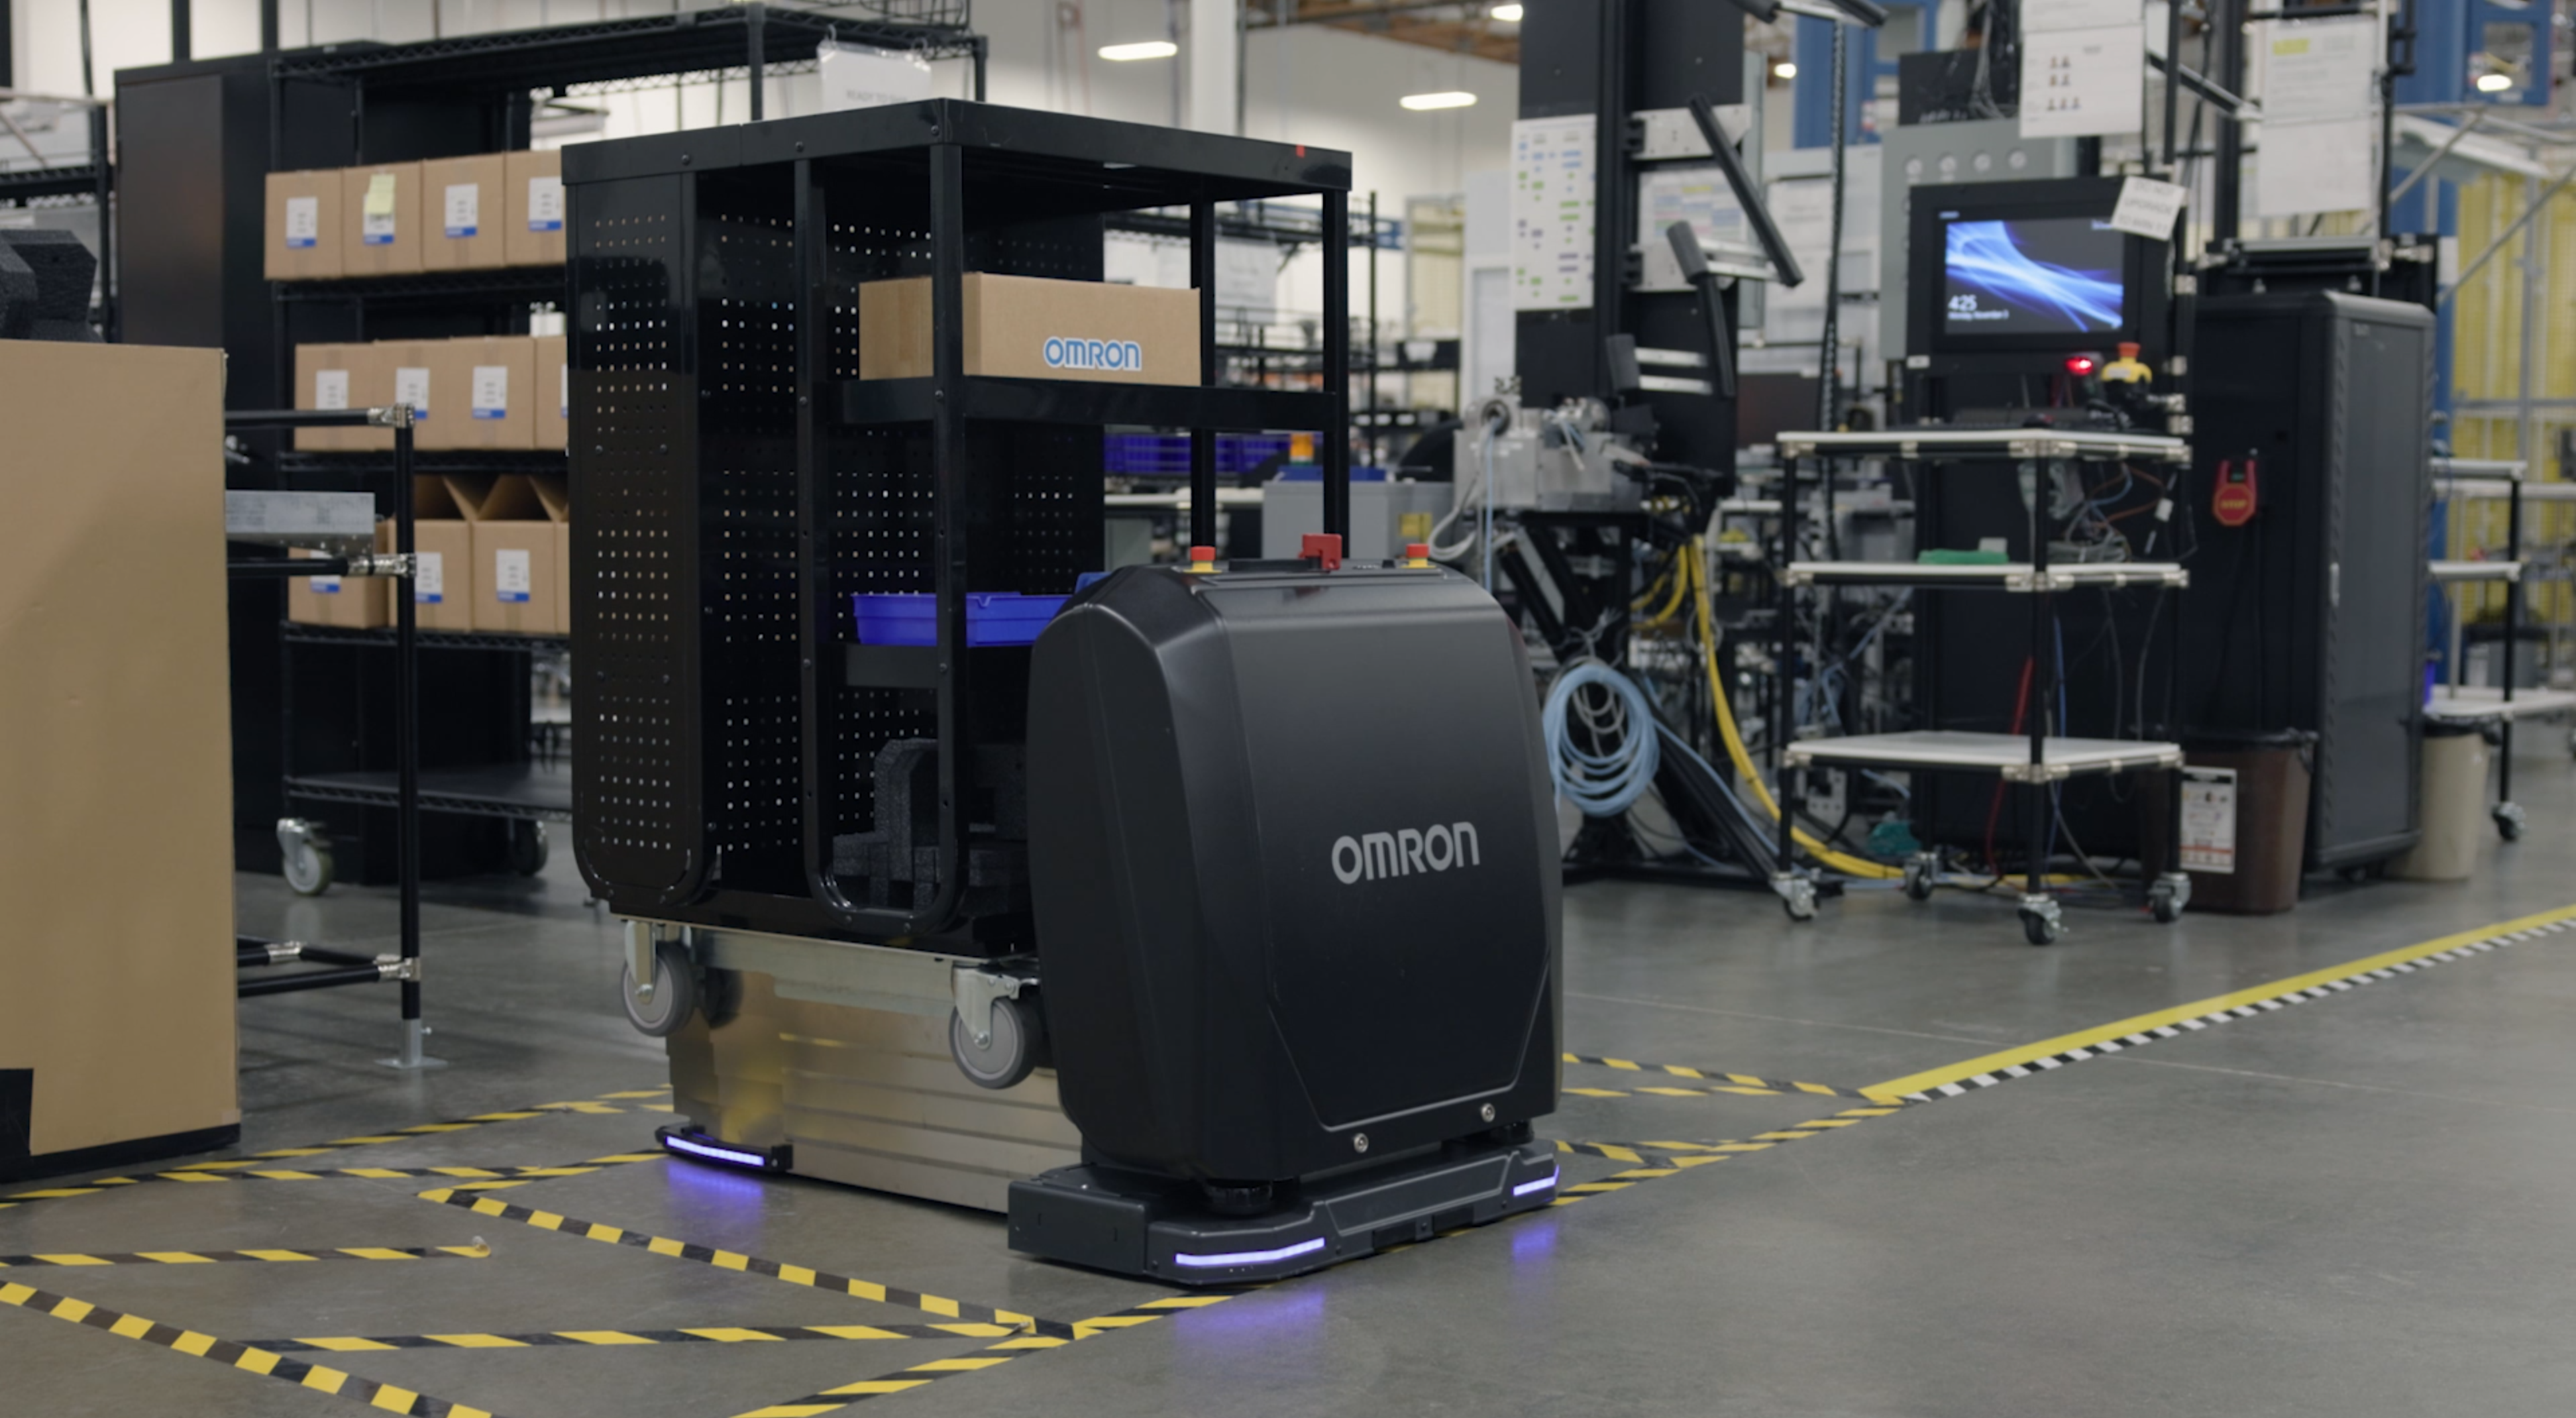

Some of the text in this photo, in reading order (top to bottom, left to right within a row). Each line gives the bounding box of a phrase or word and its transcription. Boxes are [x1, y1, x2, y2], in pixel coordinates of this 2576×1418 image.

[876, 92, 888, 104] TO
[1044, 338, 1140, 369] OMRON
[1332, 821, 1480, 884] OMRON
